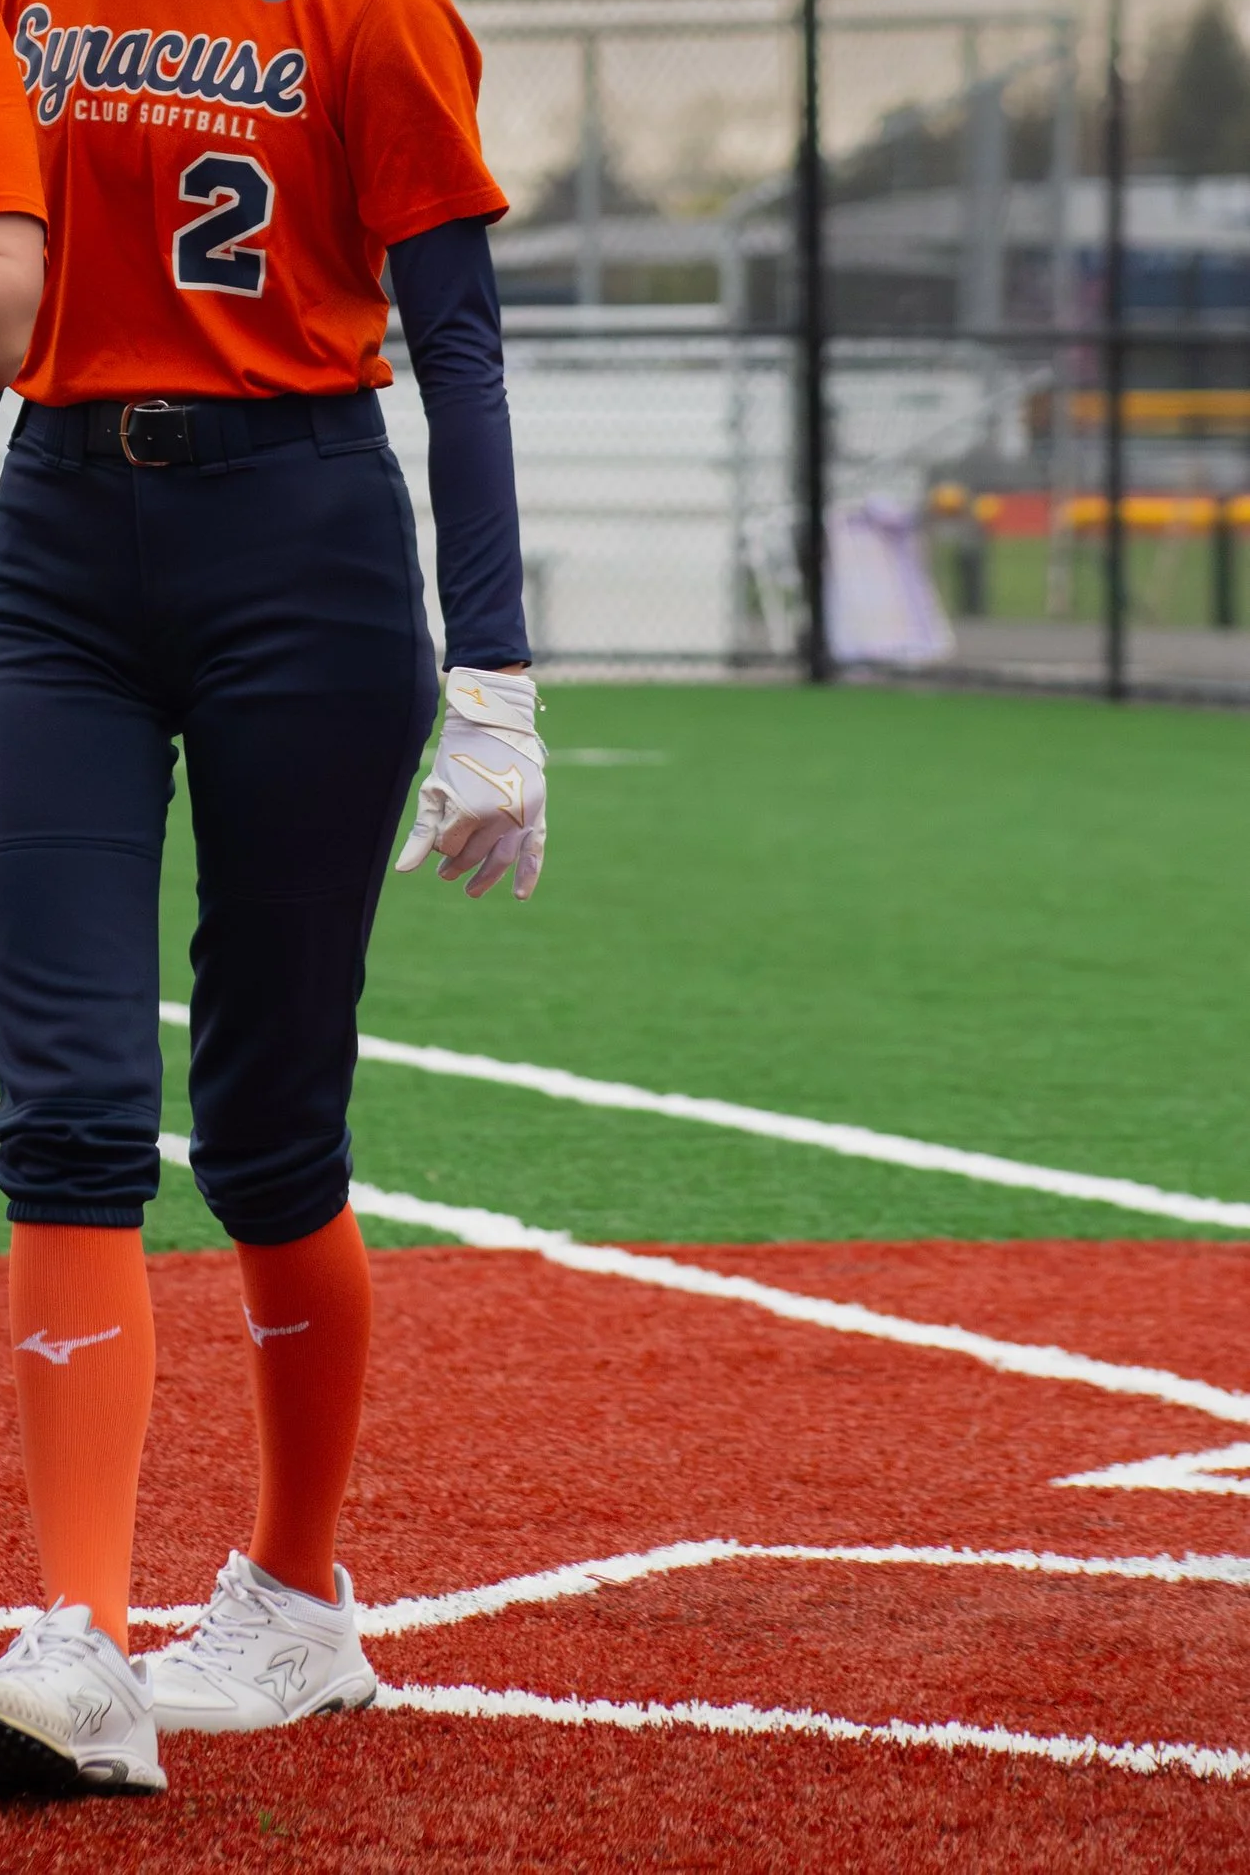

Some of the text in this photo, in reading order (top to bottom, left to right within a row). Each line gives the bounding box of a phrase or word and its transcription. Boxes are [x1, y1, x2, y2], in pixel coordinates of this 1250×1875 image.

[13, 2, 307, 126] Syracuse
[73, 99, 258, 141] CLUB SOFTBALL
[171, 150, 275, 299] 2
